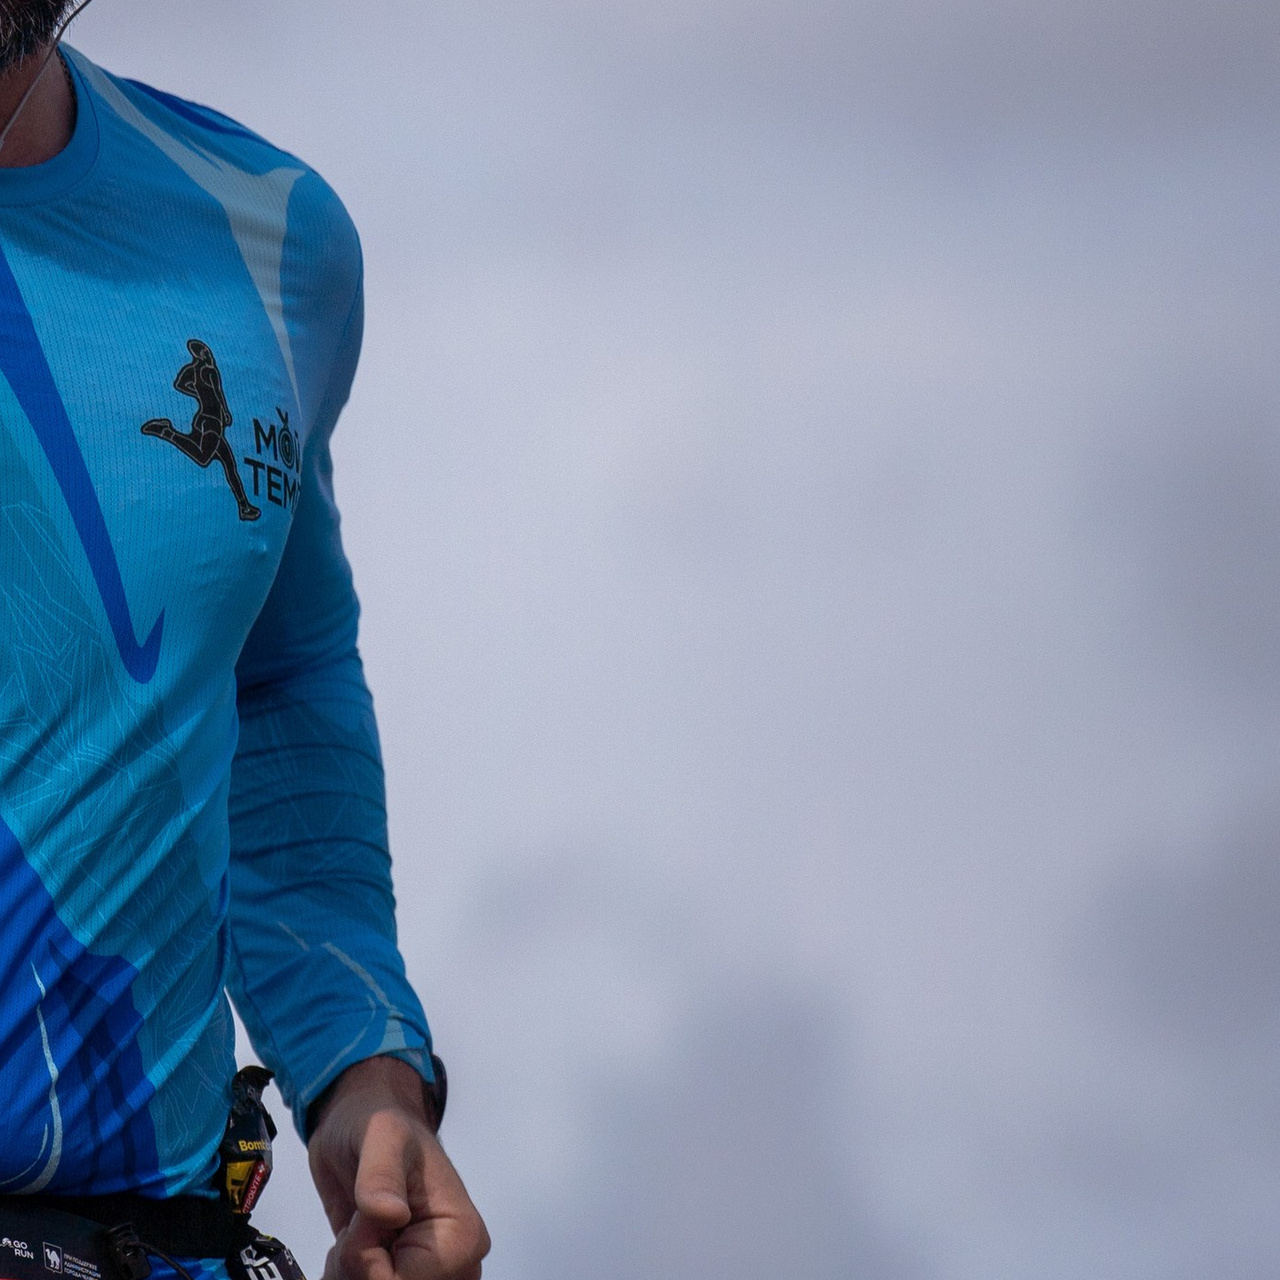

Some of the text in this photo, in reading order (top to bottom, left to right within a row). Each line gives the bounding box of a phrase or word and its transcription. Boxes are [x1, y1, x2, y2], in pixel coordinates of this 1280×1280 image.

[244, 457, 301, 515] ТЕМ
[12, 1240, 28, 1250] GO
[14, 1250, 34, 1260] RUN
